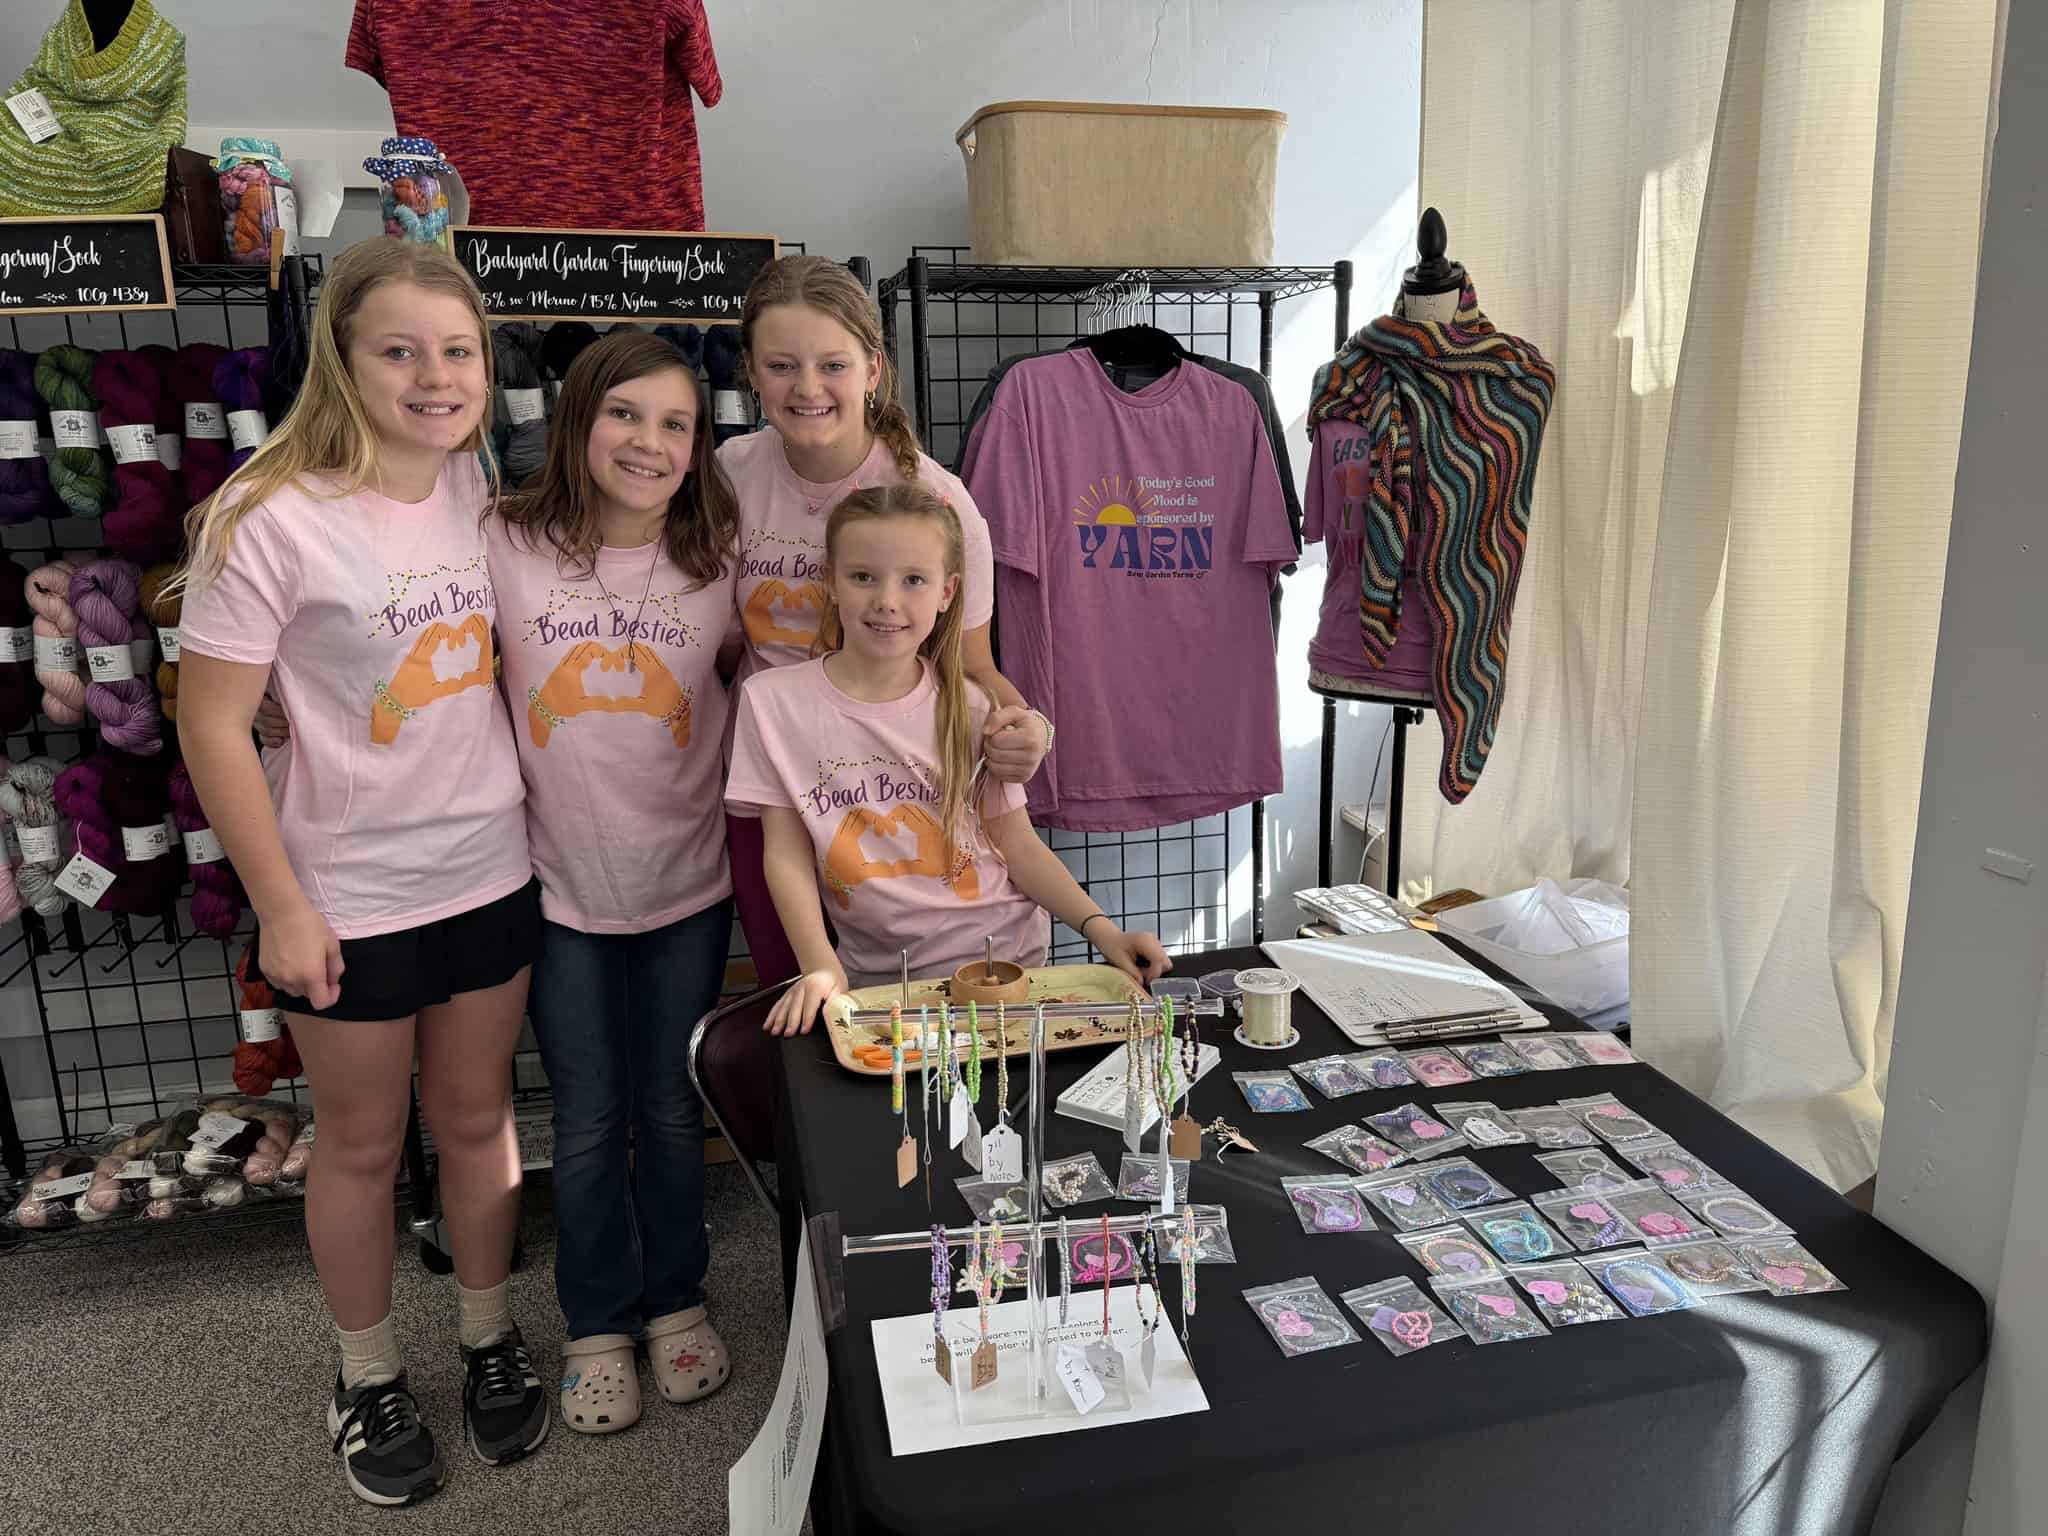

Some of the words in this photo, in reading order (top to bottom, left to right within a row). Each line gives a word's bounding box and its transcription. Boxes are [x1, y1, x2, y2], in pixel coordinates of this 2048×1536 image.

[468, 238, 549, 281] Backyard
[552, 241, 609, 280] Garden
[611, 242, 726, 284] Fingering/Sock
[76, 287, 107, 305] 100g
[590, 293, 617, 310] 15%
[620, 291, 658, 312] Nylon
[703, 295, 728, 312] 100g
[1137, 475, 1182, 491] Today's
[1184, 475, 1215, 488] Good
[1153, 494, 1185, 506] Mood
[1188, 493, 1199, 505] is
[1200, 511, 1215, 526] by
[1079, 525, 1212, 569] YARN
[381, 604, 444, 637] Bead
[535, 614, 599, 646] Bead
[608, 609, 686, 648] Besties
[808, 786, 868, 816] Bead
[874, 773, 941, 804] Bestie
[955, 1347, 973, 1358] will
